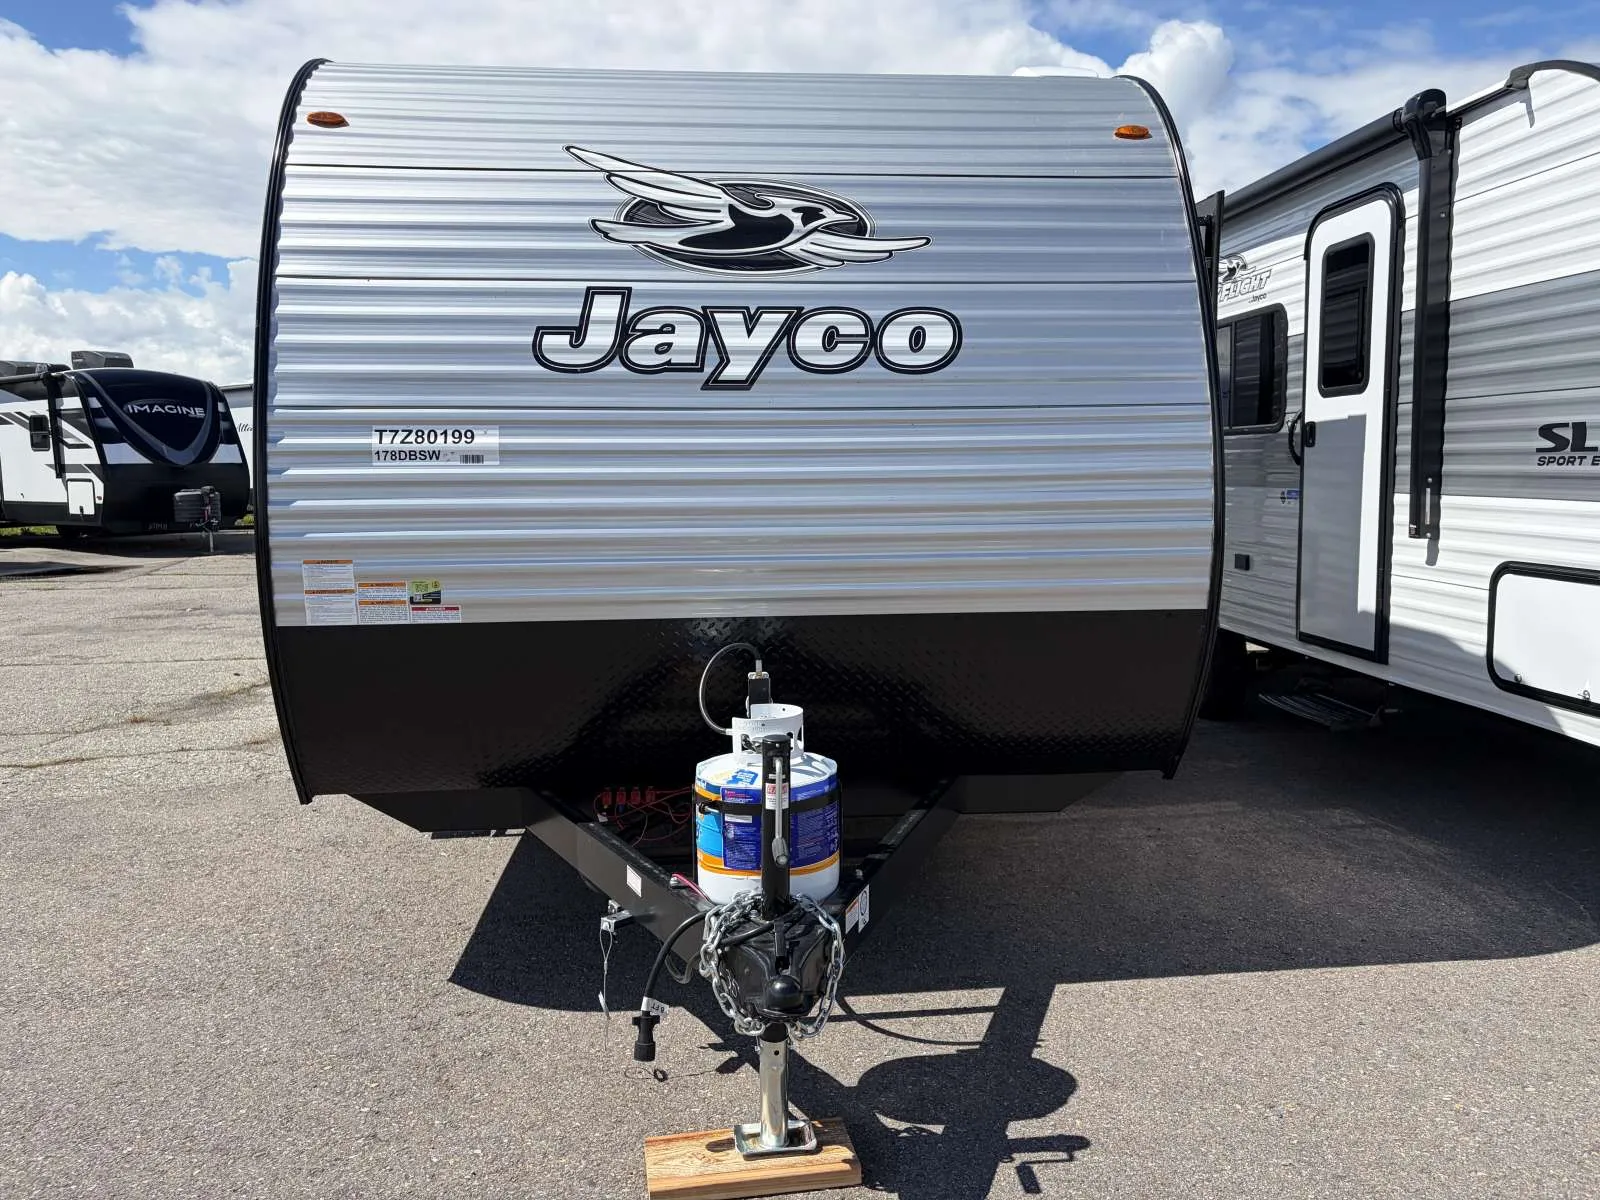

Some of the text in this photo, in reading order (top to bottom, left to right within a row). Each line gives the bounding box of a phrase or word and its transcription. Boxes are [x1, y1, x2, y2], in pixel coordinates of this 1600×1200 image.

[532, 286, 963, 391] Jayco
[127, 404, 205, 417] IMAGINE
[374, 429, 475, 445] T7Z80199
[1535, 421, 1599, 453] SL
[374, 450, 441, 461] 178DBSW
[1537, 455, 1587, 466] SPORT
